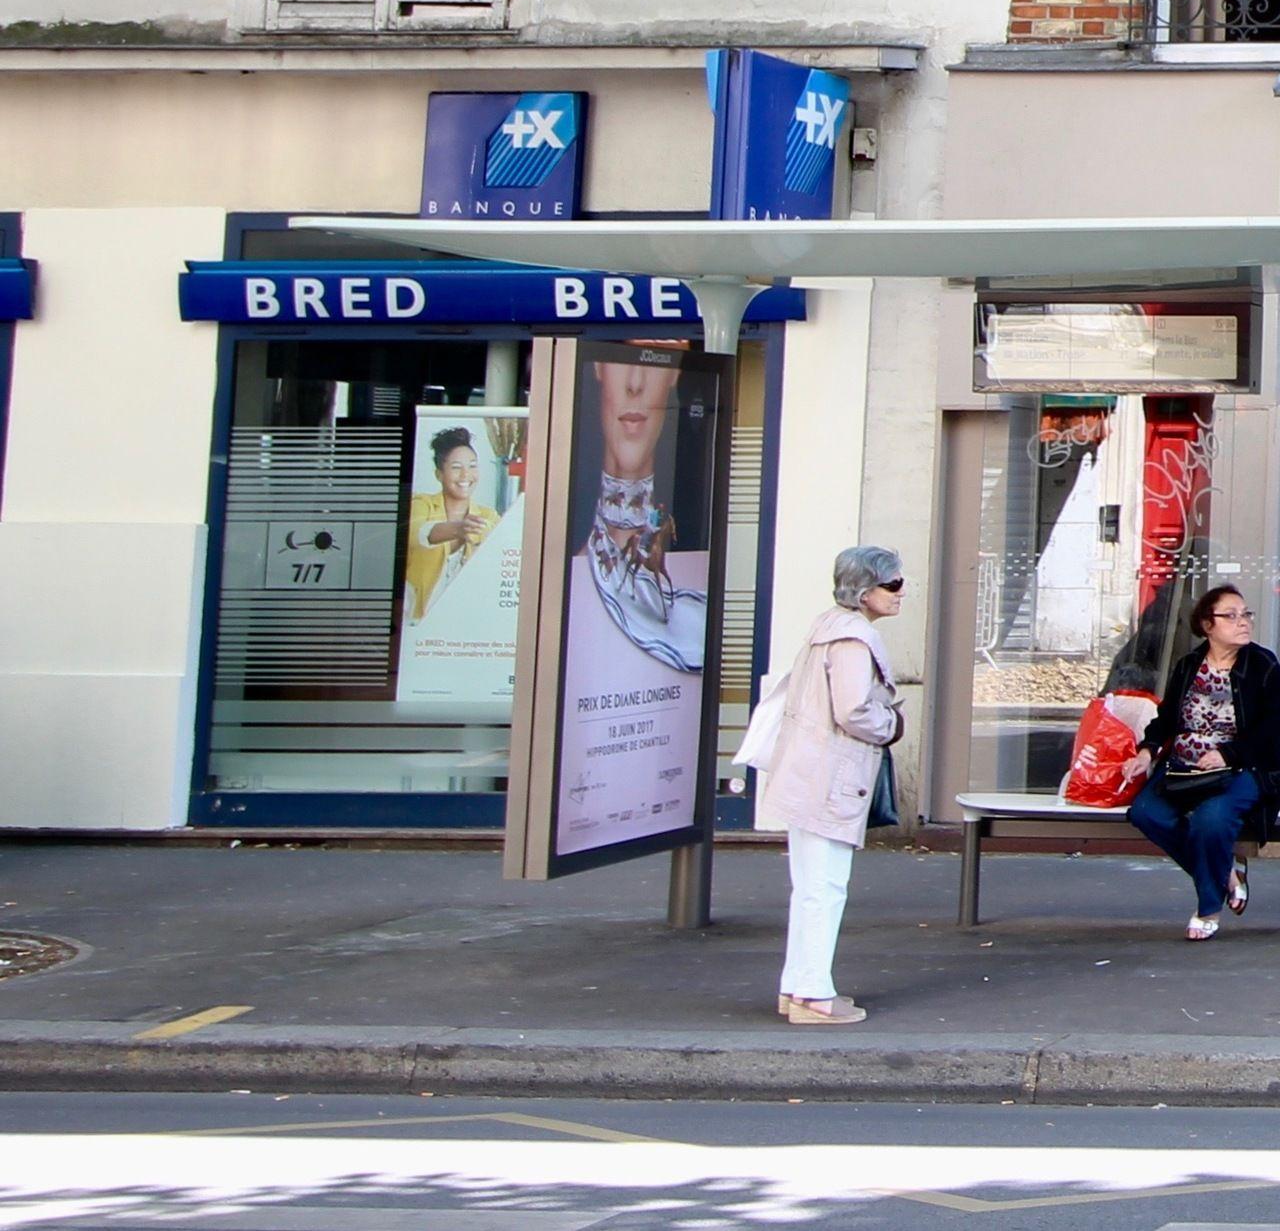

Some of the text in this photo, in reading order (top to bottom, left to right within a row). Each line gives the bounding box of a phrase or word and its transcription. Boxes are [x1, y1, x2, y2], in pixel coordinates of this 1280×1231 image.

[429, 201, 564, 215] BANQUE
[245, 278, 426, 318] BRED
[554, 277, 703, 318] BRE
[292, 564, 325, 583] 7/7
[500, 580, 514, 588] AU
[500, 590, 512, 598] DE
[577, 685, 681, 713] PRIX DE DIANE LONGINES
[608, 720, 654, 739] 18 JUIN 2017
